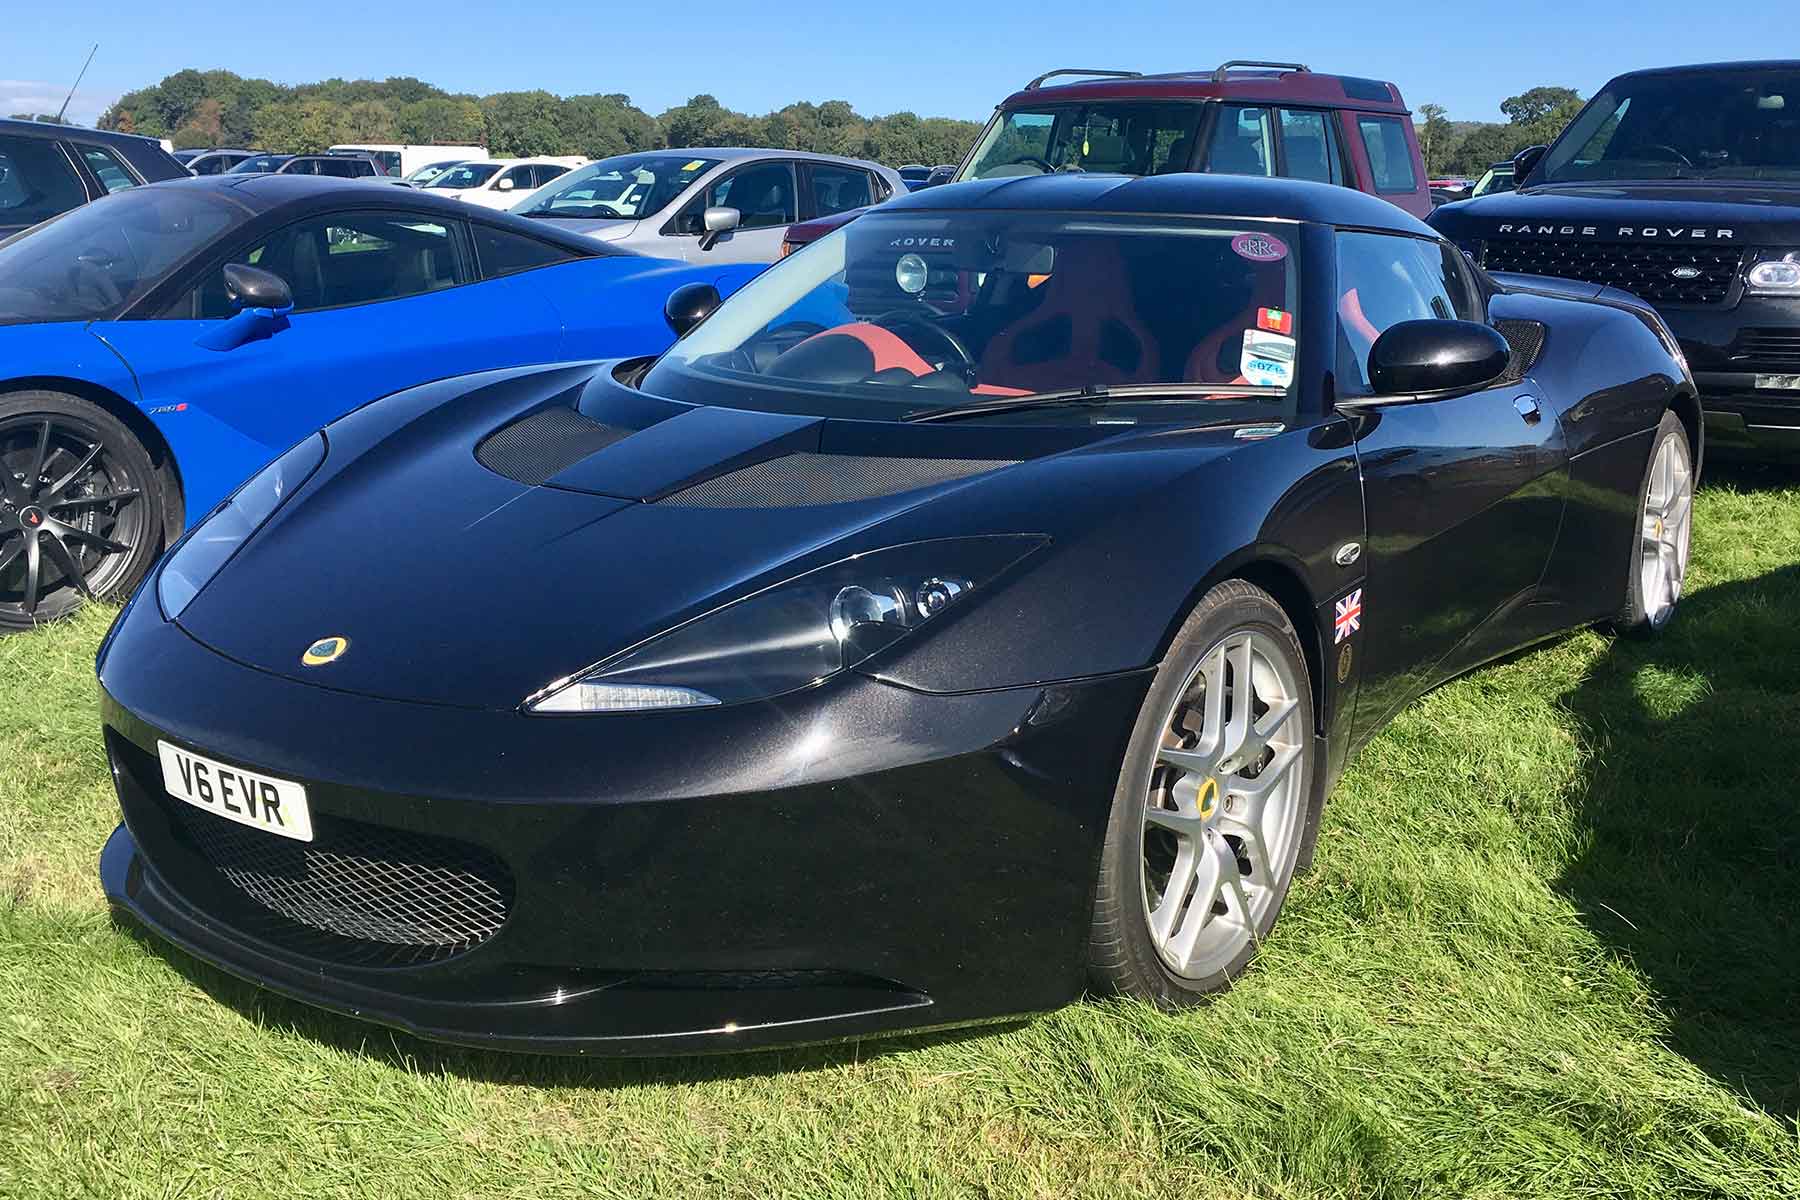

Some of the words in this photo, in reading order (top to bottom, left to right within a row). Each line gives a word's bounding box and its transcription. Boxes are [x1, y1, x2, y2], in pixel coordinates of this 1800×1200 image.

[1499, 224, 1597, 236] RANGE
[1618, 227, 1734, 239] ROVER
[176, 753, 214, 804] V6
[217, 769, 285, 827] EVR
